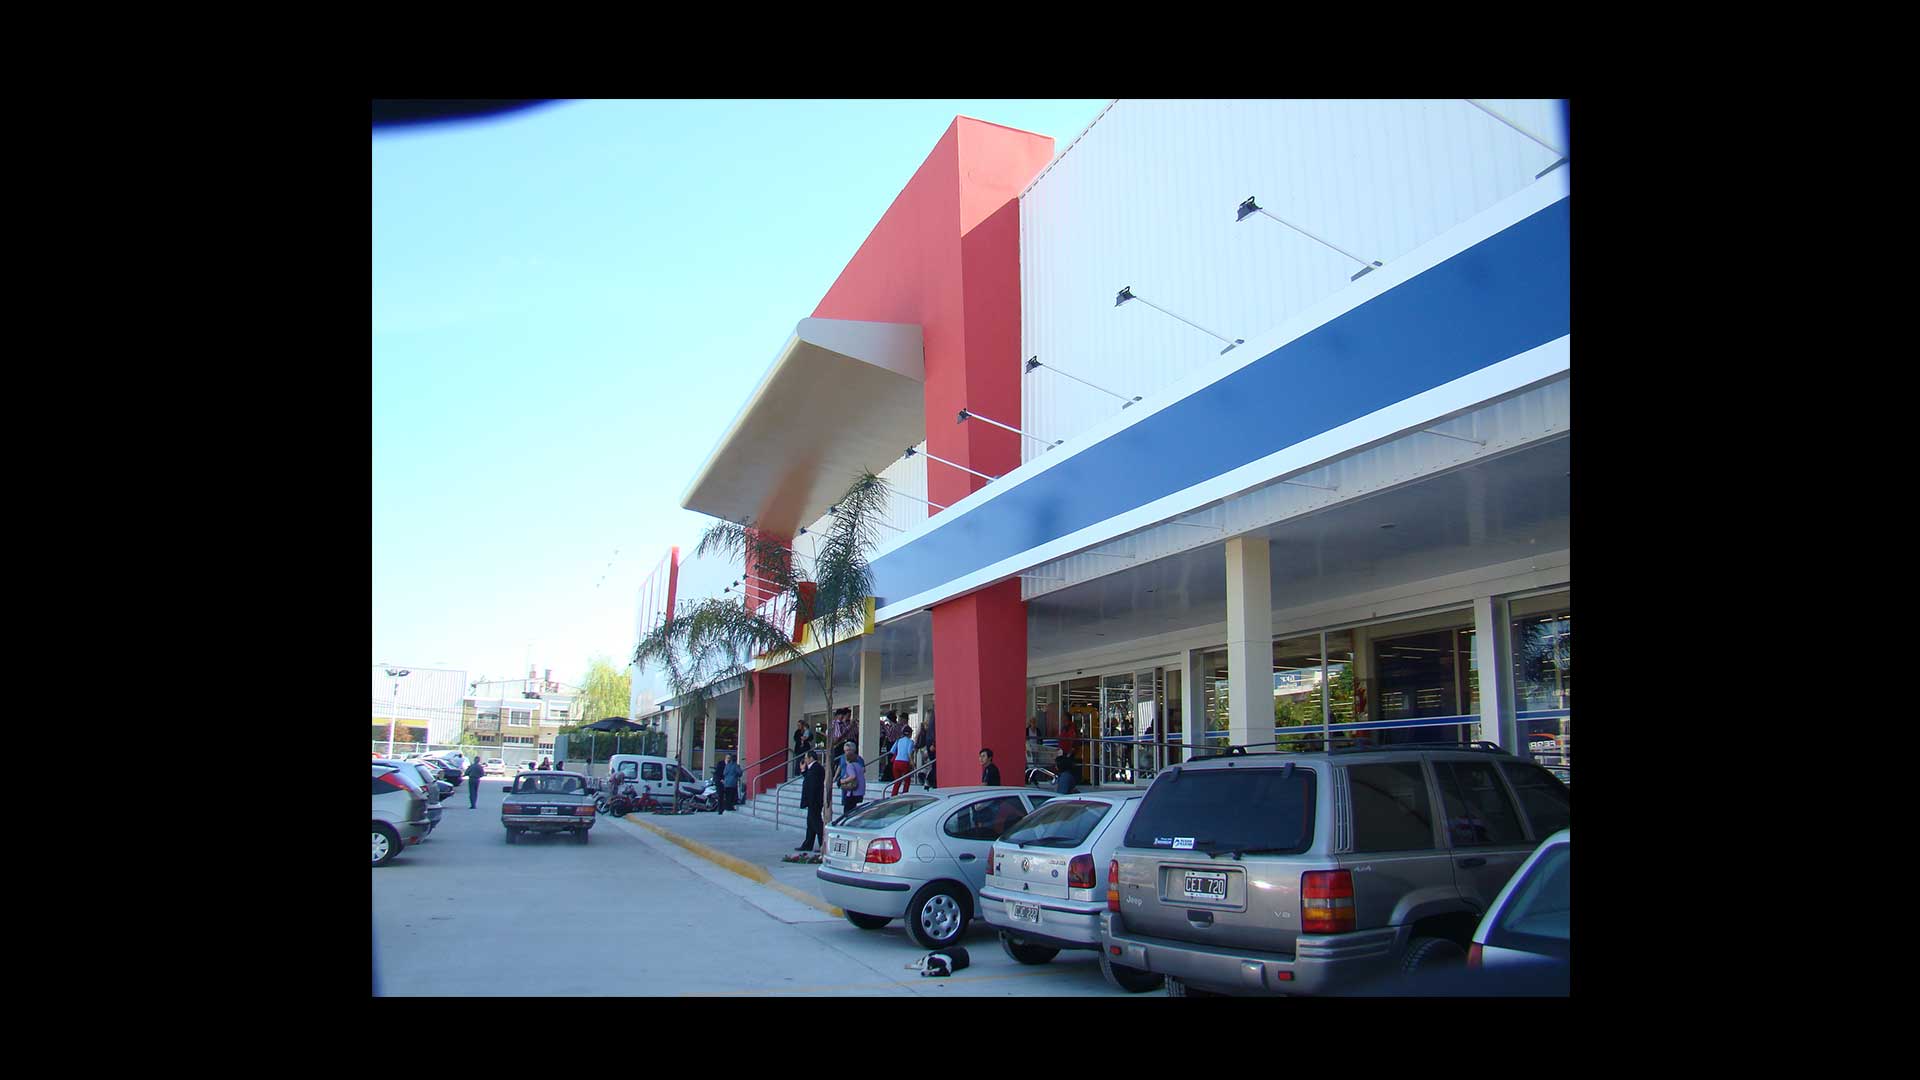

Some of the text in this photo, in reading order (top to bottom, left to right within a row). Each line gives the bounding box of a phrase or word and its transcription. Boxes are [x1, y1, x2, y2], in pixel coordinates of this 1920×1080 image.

[1185, 877, 1224, 894] CEI 720
[1126, 895, 1143, 907] Jeep
